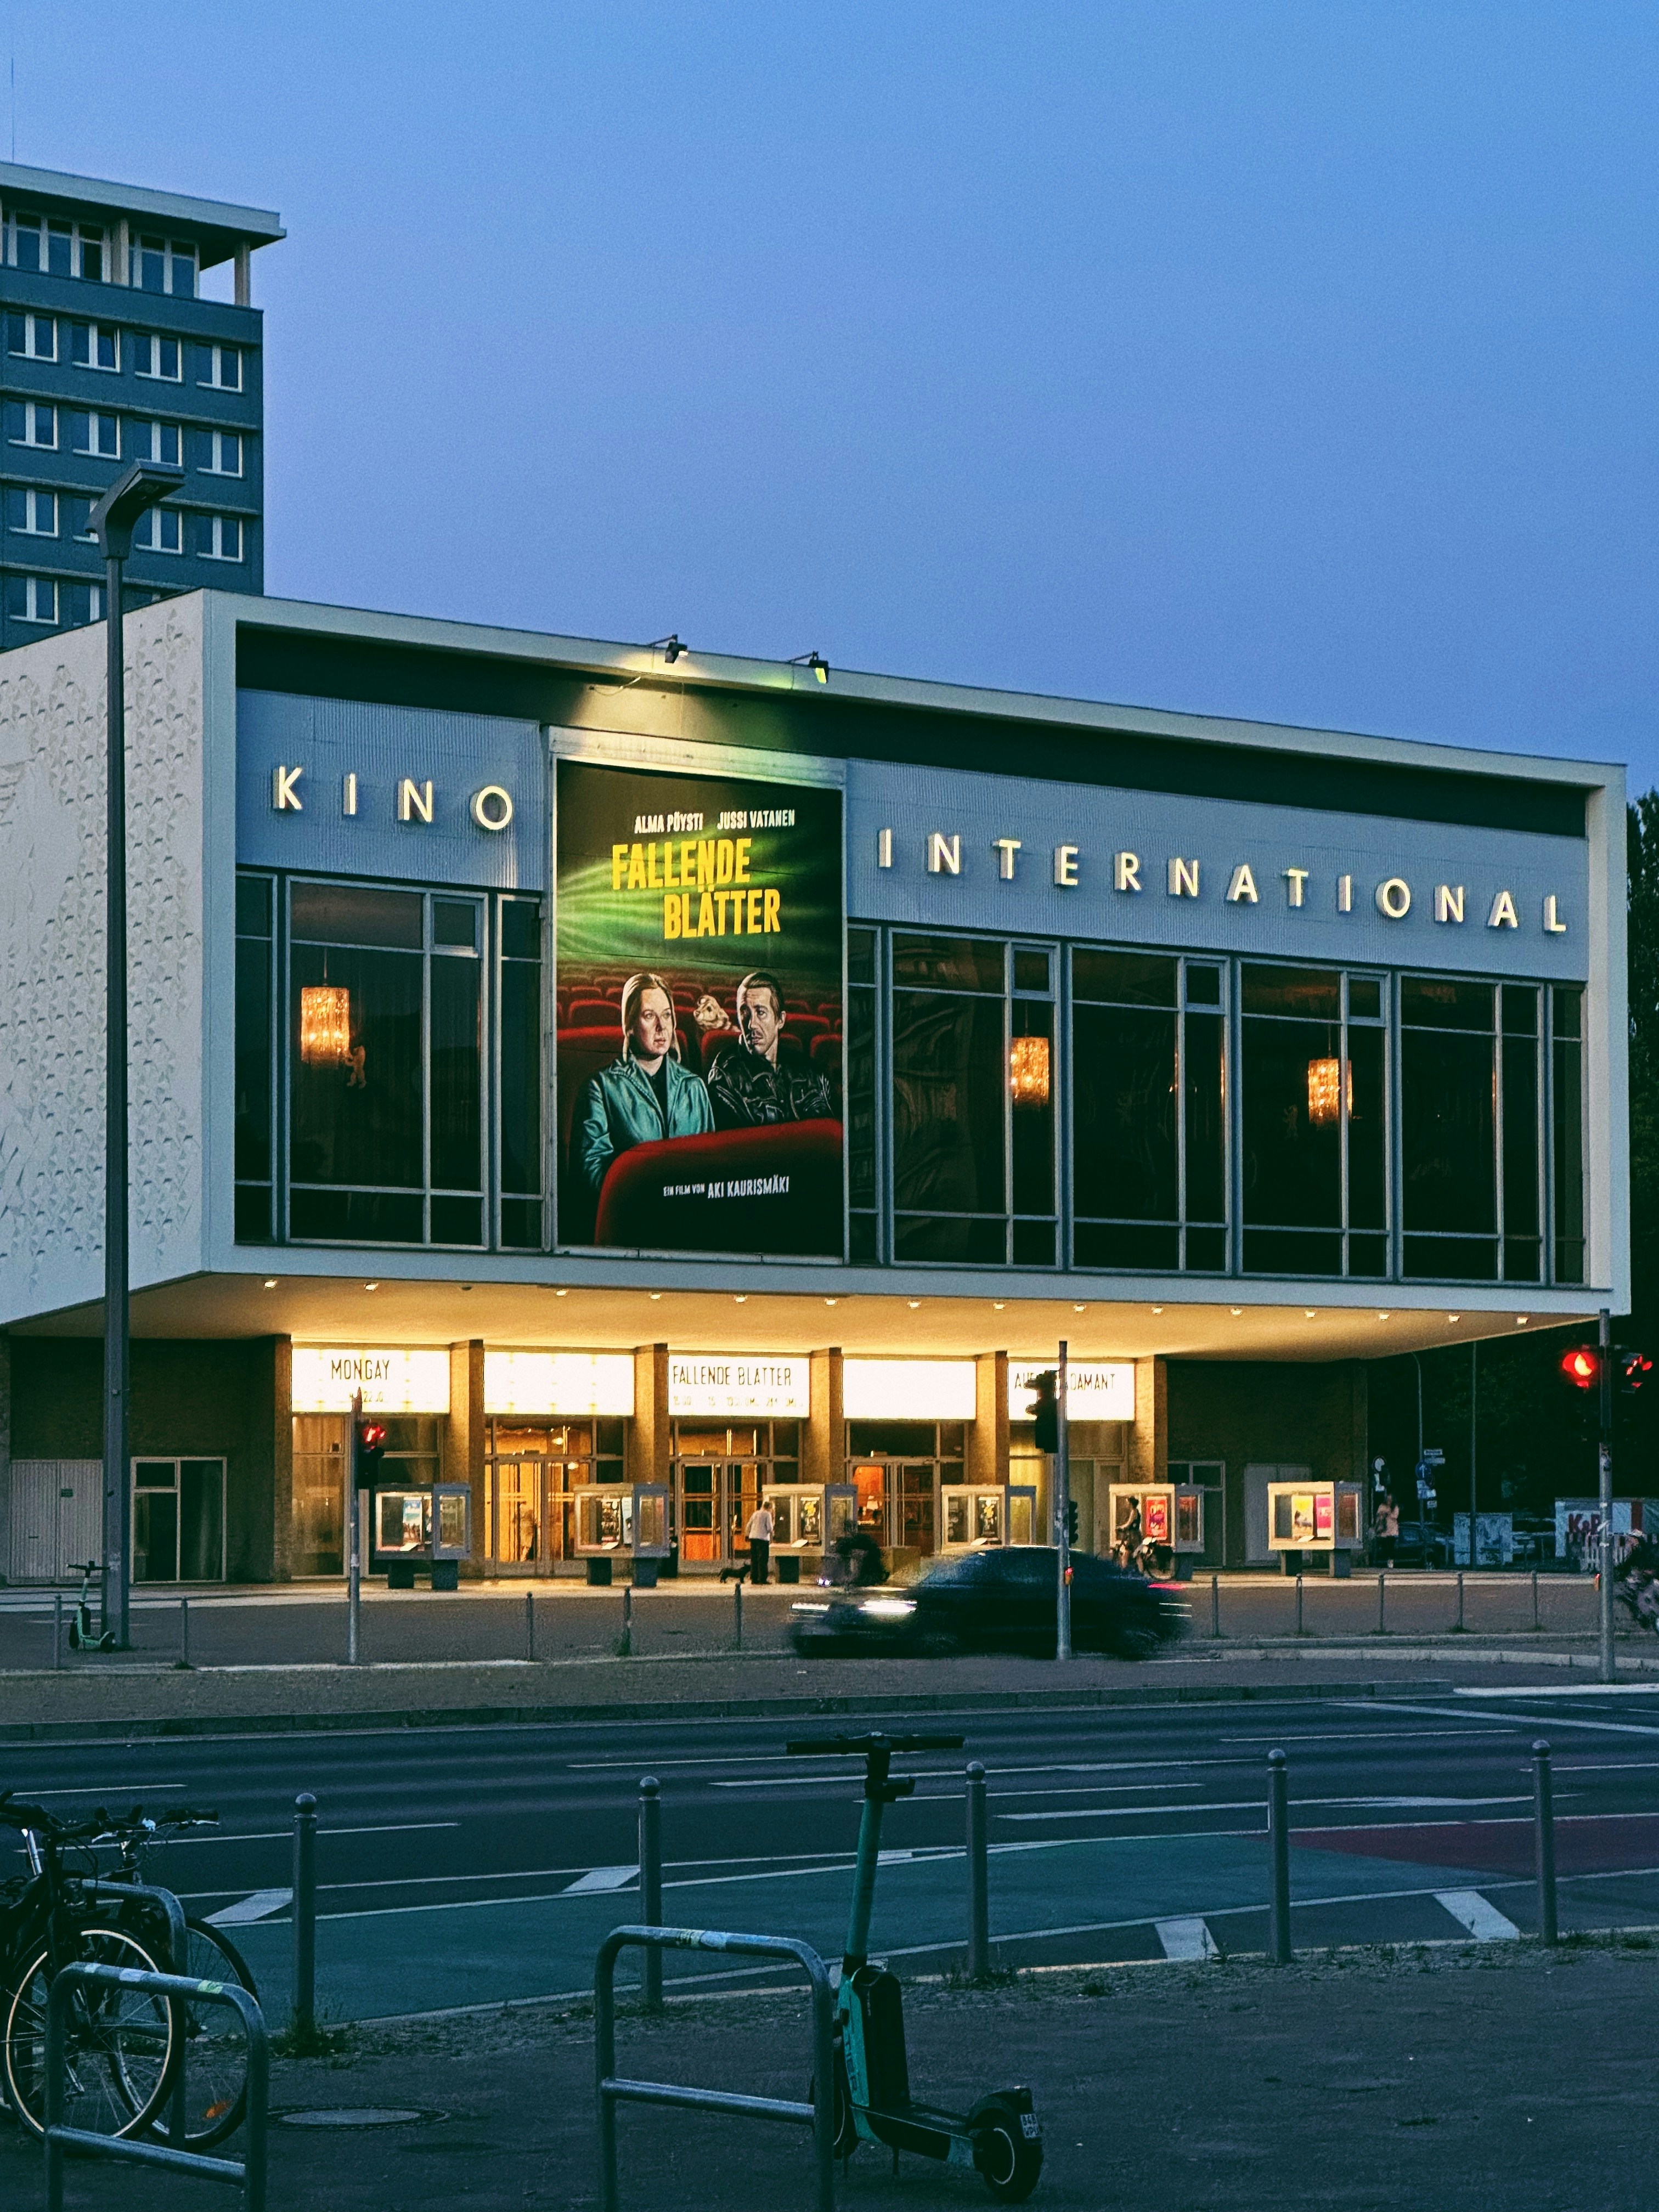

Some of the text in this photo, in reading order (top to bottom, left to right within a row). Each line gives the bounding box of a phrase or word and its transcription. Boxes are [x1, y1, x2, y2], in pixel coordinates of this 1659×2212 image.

[634, 809, 795, 834] ALMA PÖYSTI JUSSI VATANEN
[273, 766, 1567, 933] KINO INTERNATIONAL
[612, 838, 752, 890] FALLENDE
[664, 884, 781, 940] BLÄTTER
[663, 1173, 789, 1199] EIN FILM VON AKI KAURISMÄKI
[331, 1359, 390, 1380] MONGAY
[673, 1365, 731, 1385] FALLENDE
